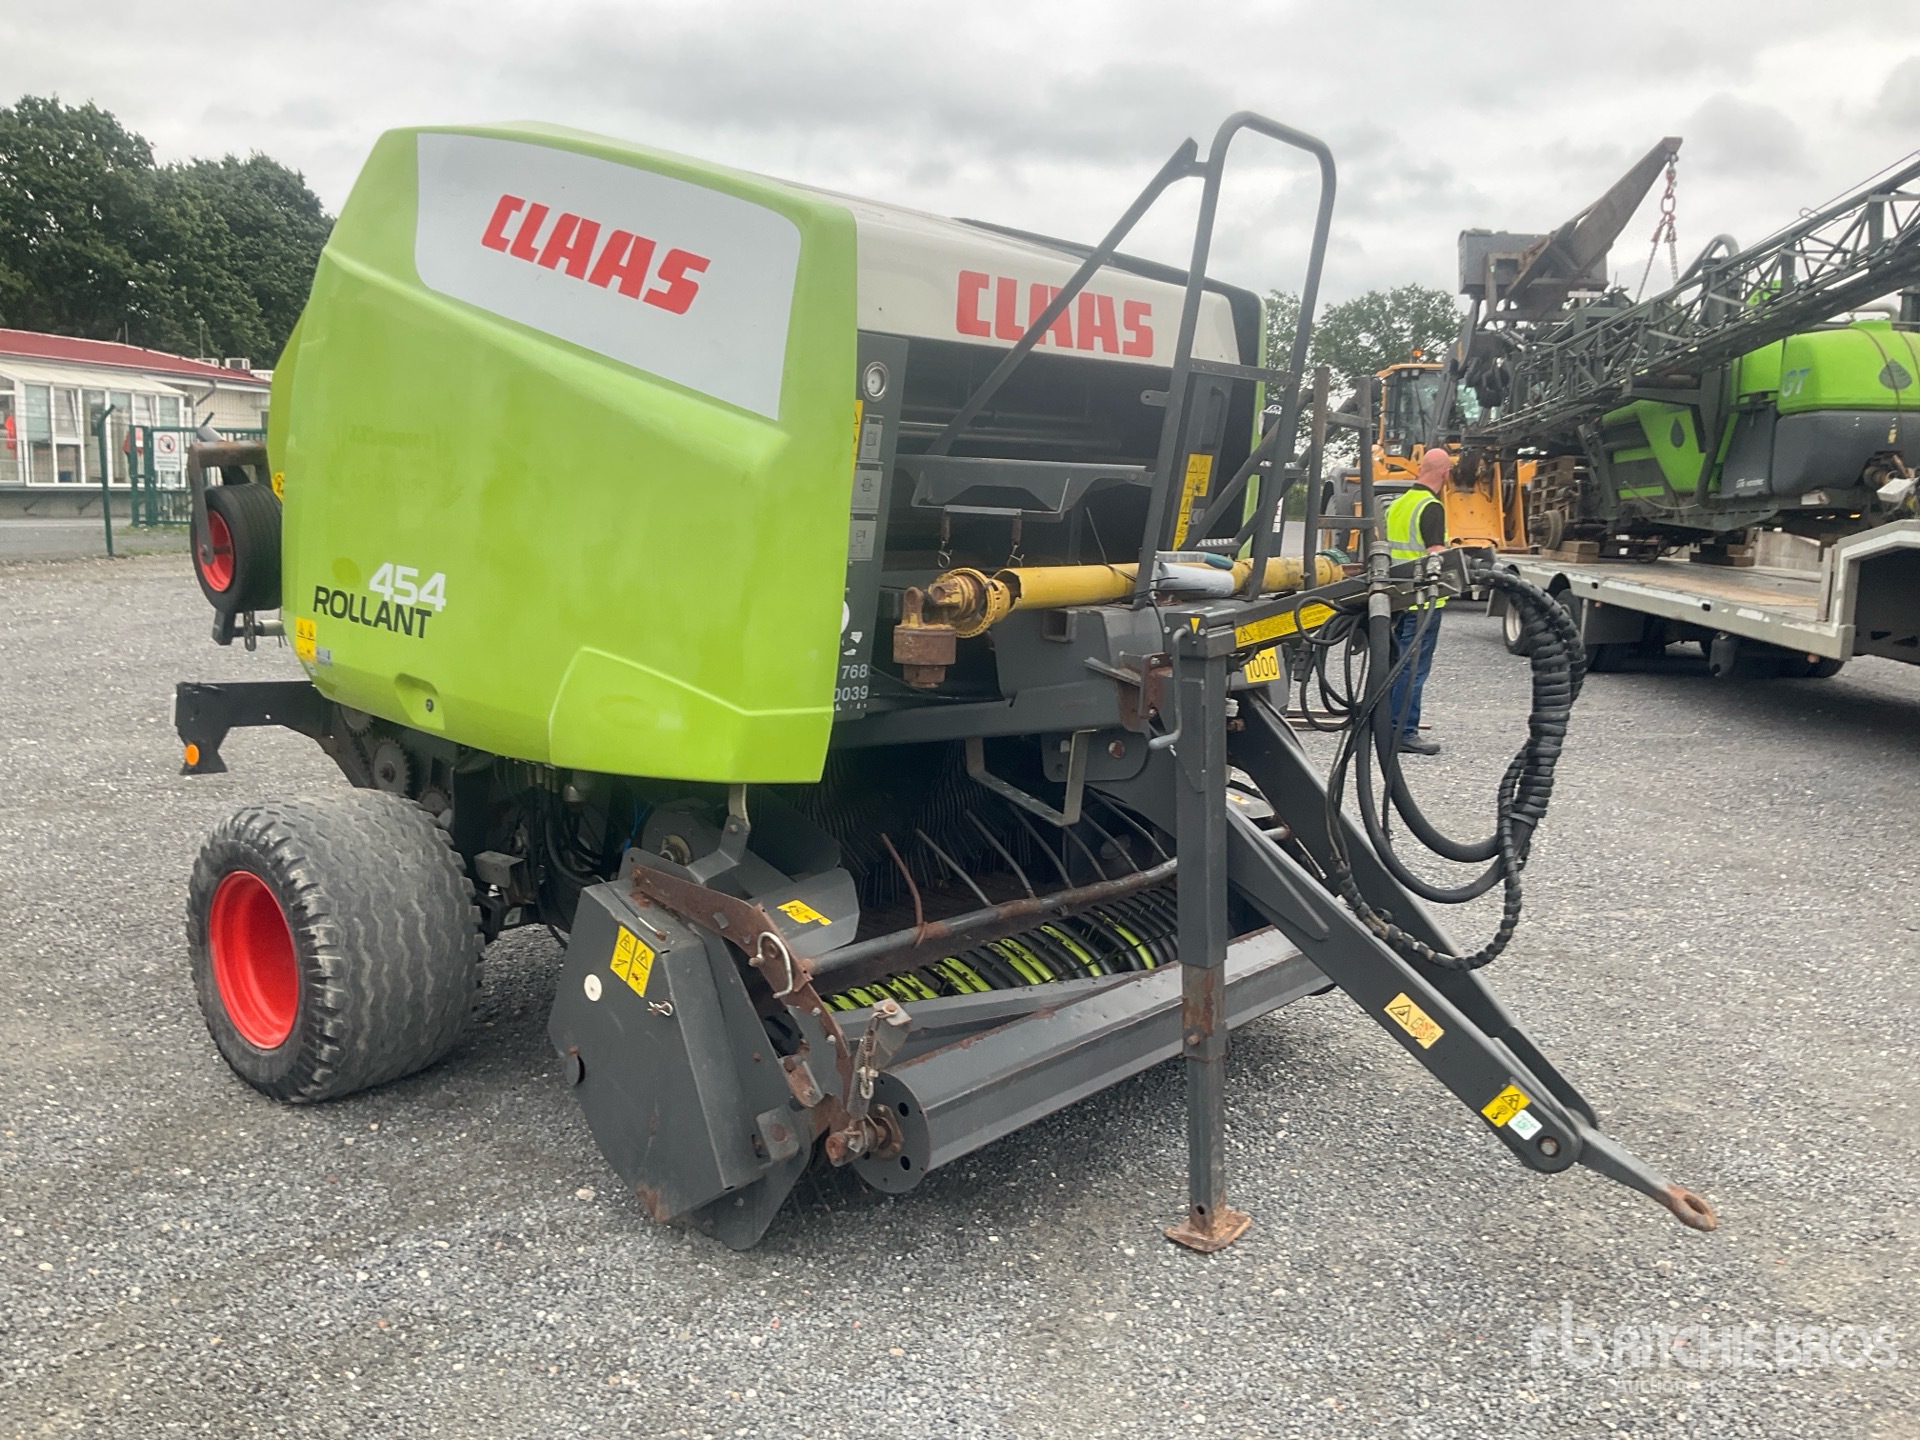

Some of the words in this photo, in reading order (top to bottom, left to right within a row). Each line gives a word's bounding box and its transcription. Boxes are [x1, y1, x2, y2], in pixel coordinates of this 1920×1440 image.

[481, 194, 711, 315] CLAAS
[313, 585, 432, 639] ROLLANT
[369, 563, 447, 612] 454
[842, 664, 868, 680] 768
